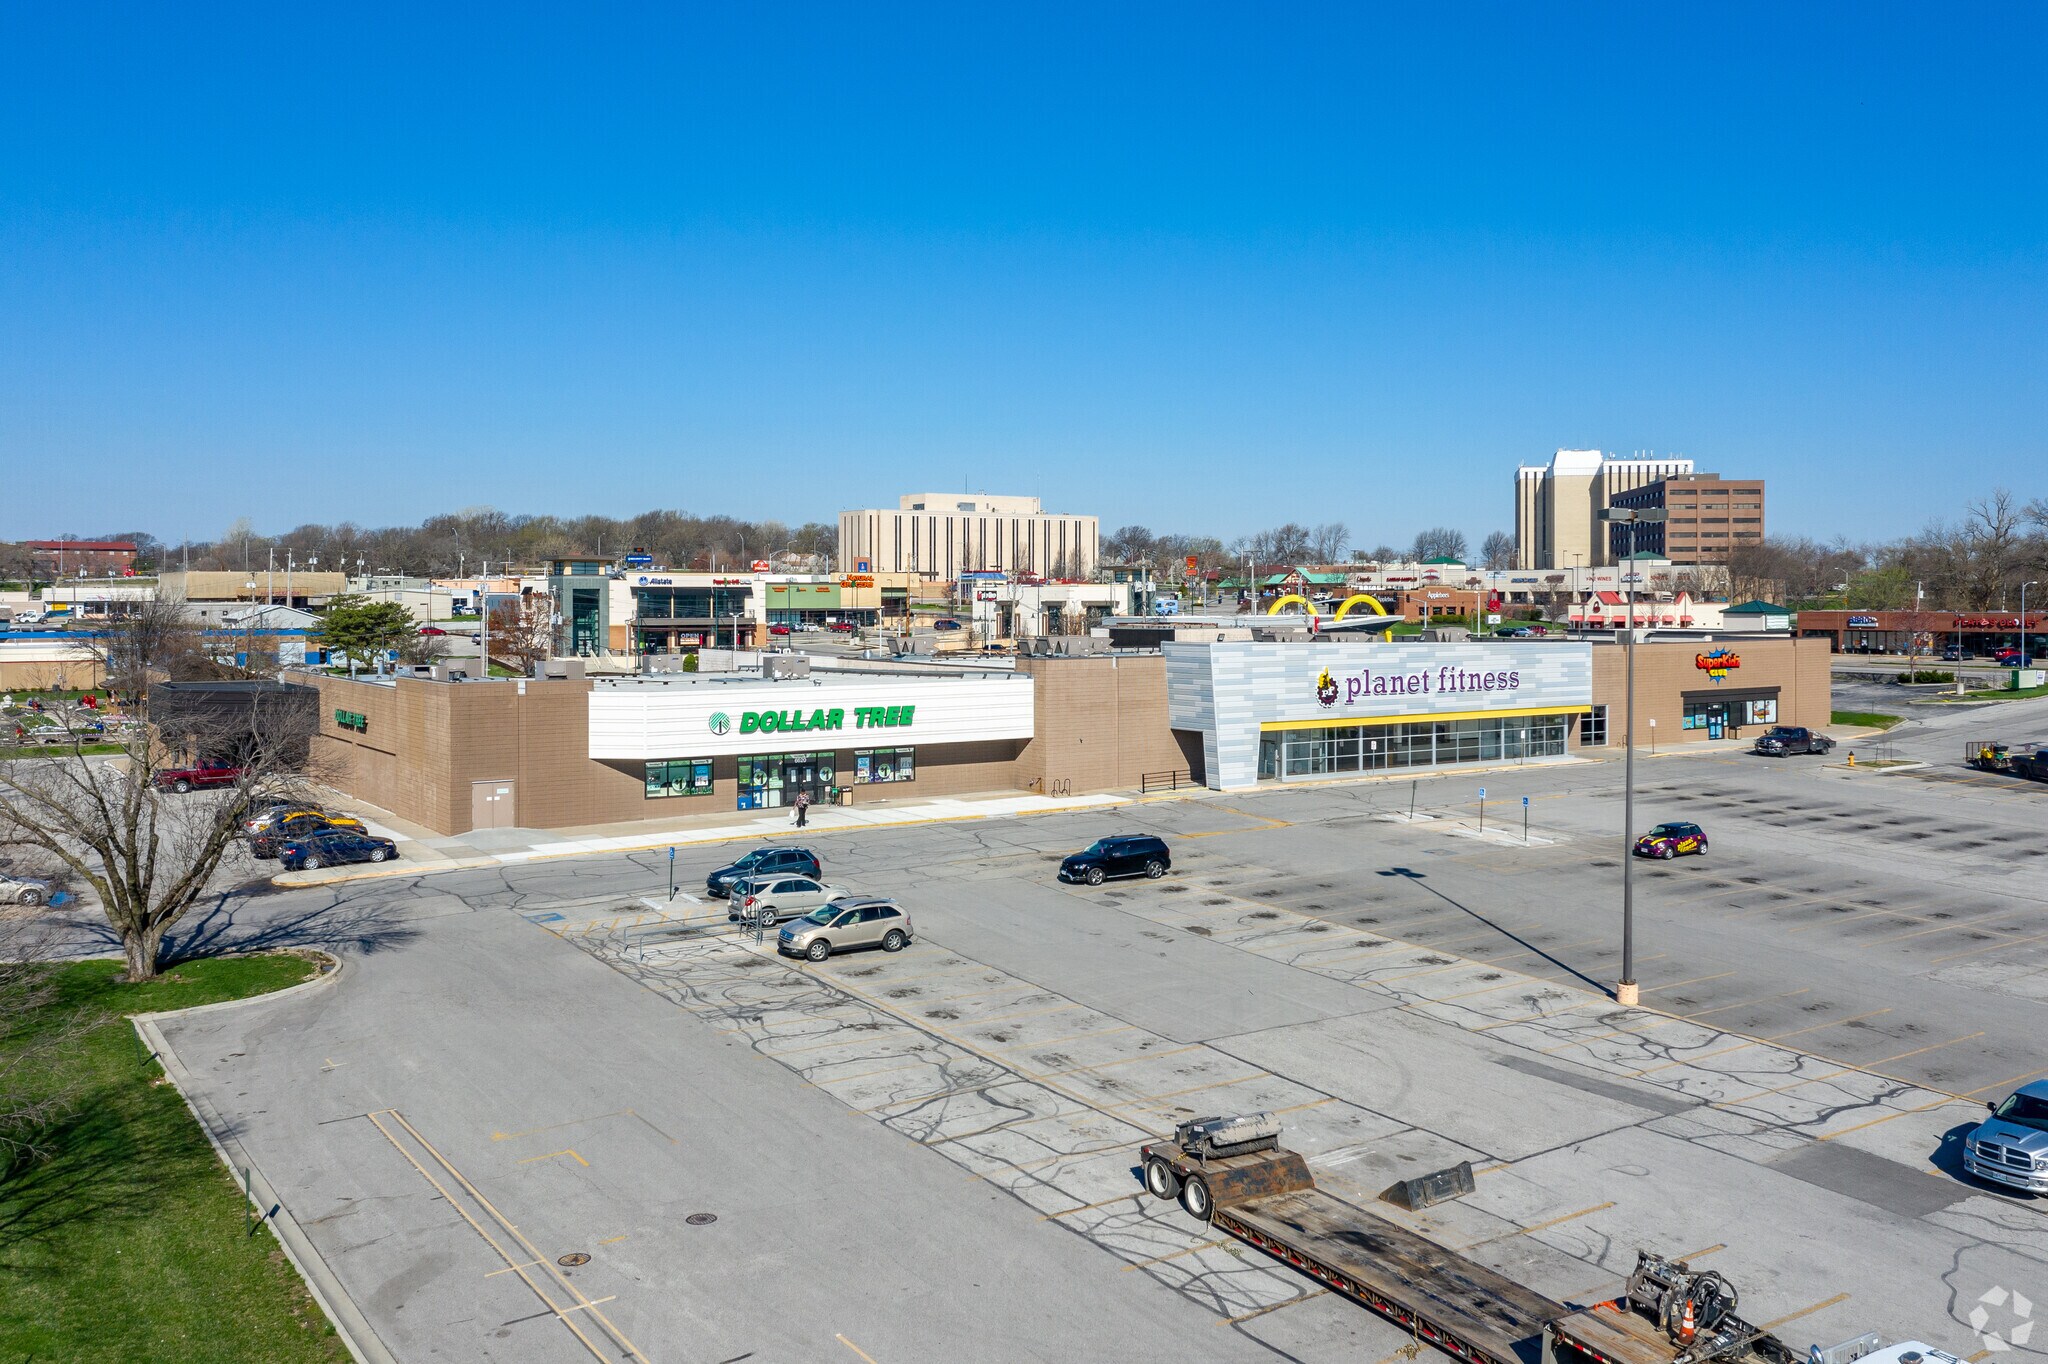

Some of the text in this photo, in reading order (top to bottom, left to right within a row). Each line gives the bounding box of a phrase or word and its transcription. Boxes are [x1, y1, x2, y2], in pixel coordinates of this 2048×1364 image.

[650, 577, 672, 585] Allstate
[1696, 654, 1740, 670] SuperKidz
[1709, 669, 1727, 677] CLUB
[1346, 666, 1520, 704] planet fitness
[740, 705, 915, 734] DOLLAR TREE
